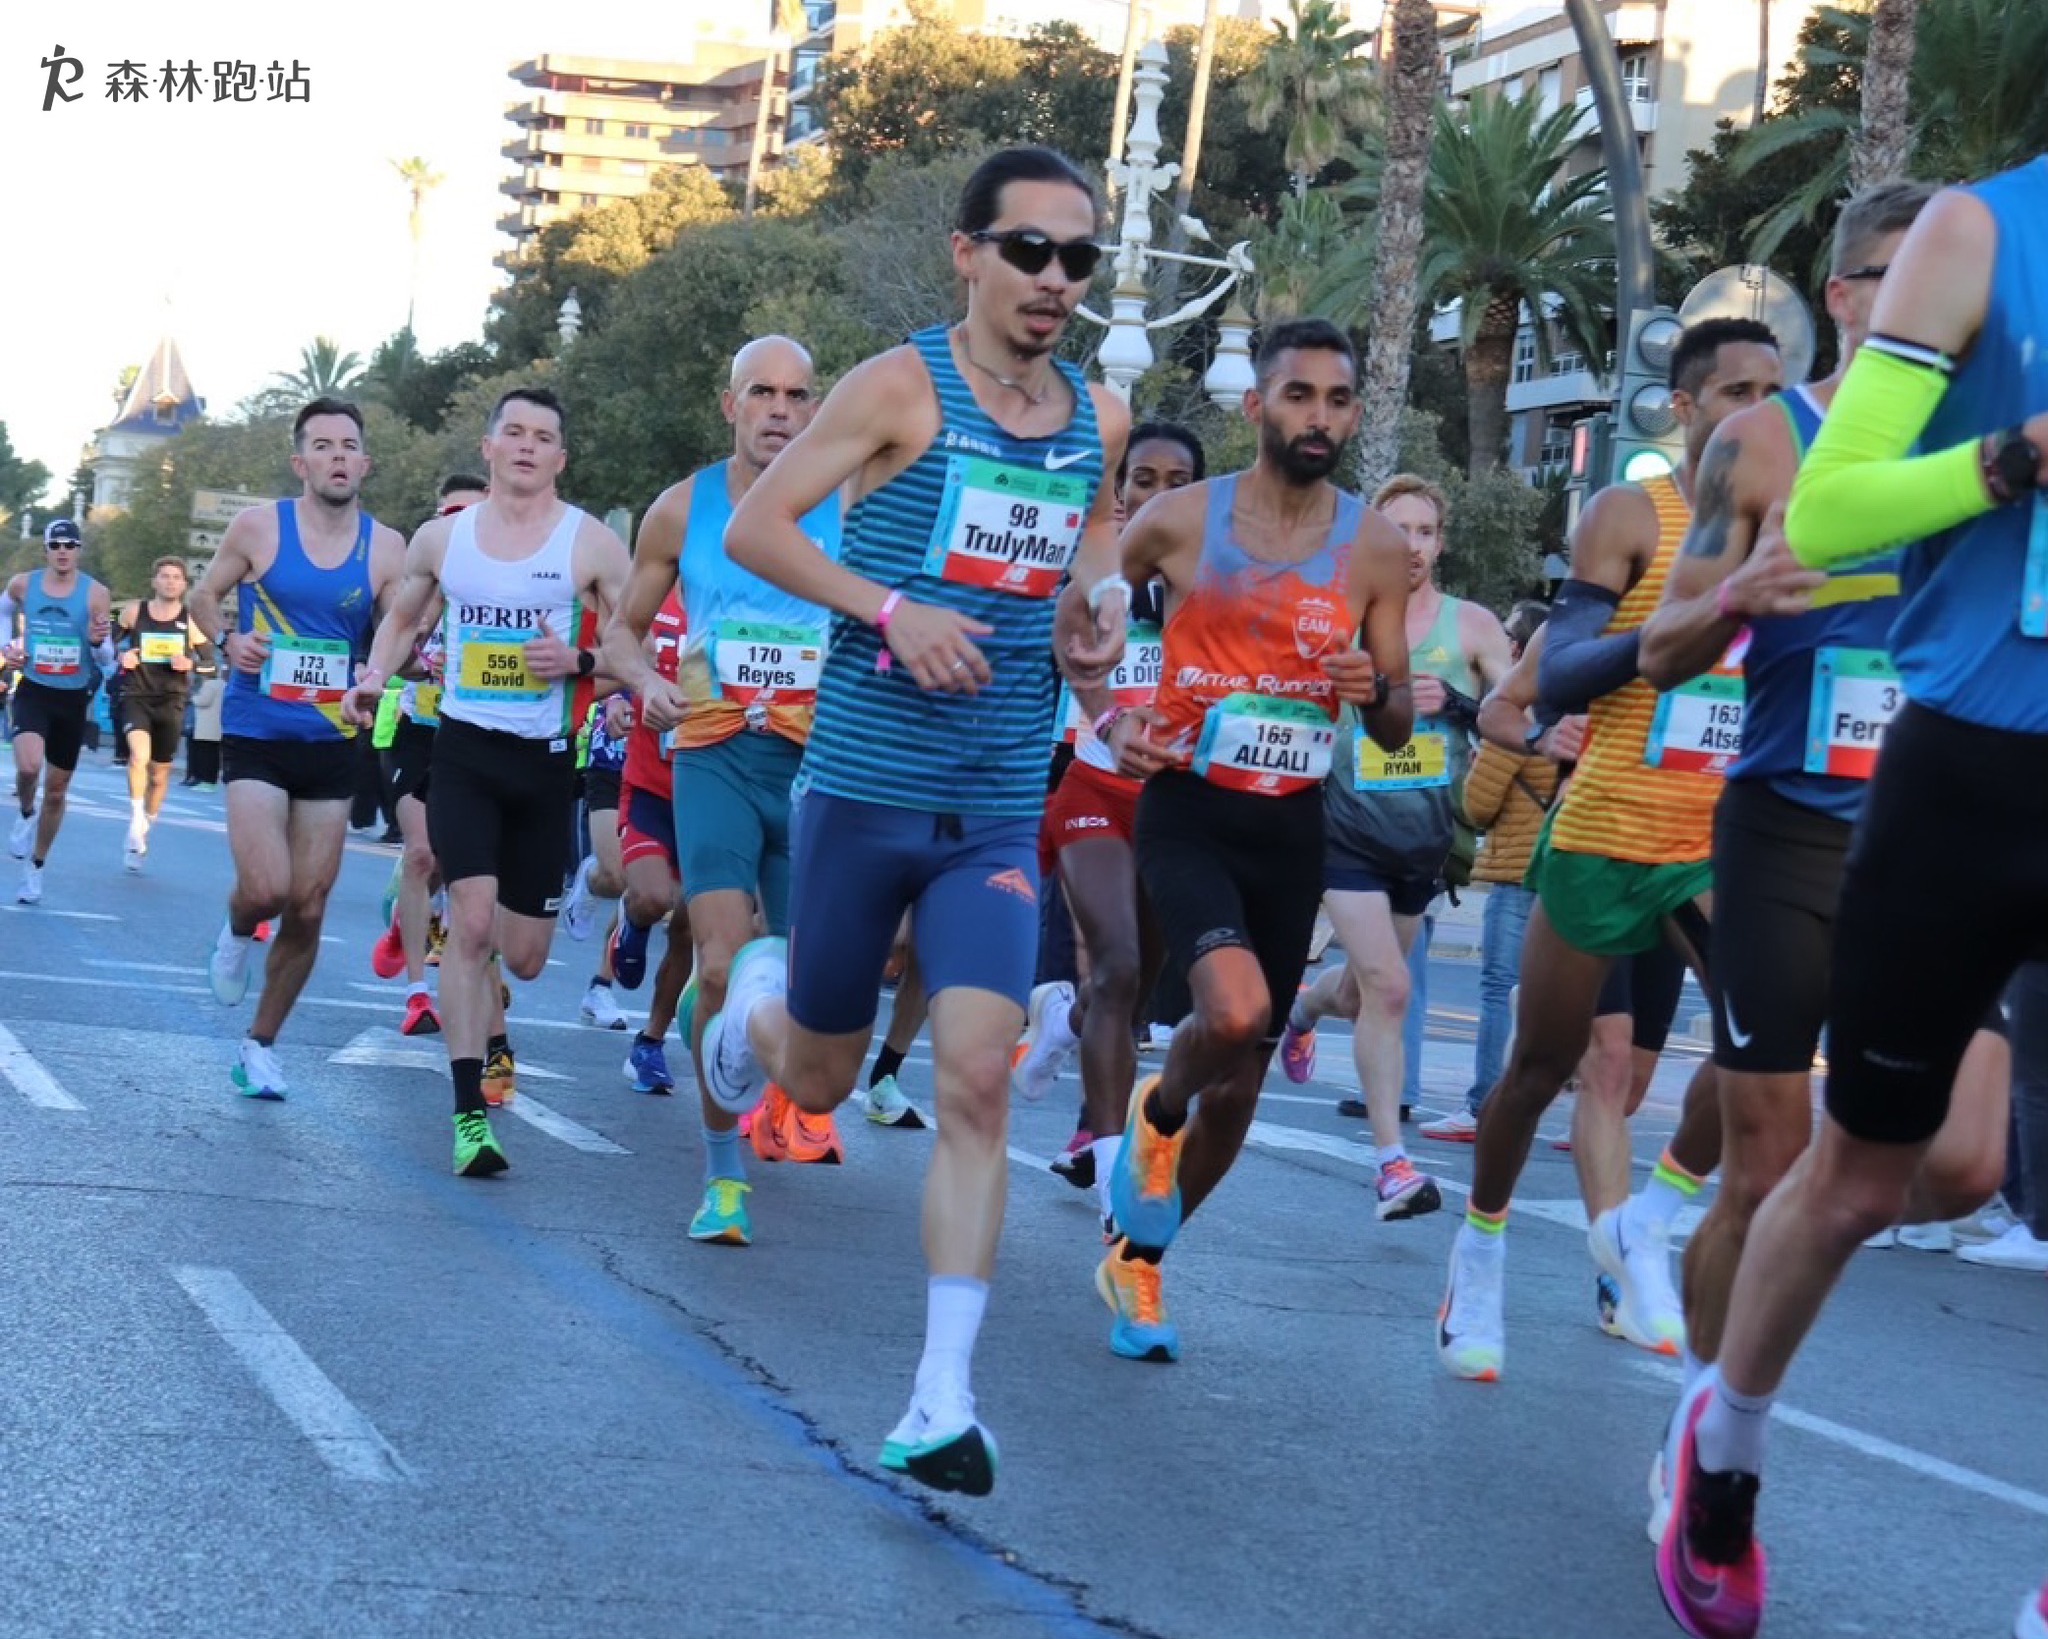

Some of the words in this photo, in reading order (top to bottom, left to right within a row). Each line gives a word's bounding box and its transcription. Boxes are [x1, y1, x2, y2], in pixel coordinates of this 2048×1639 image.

[1009, 503, 1040, 530] 98
[965, 523, 1067, 565] TrulyMan
[1298, 616, 1331, 634] EAM
[299, 655, 325, 670] 173
[487, 654, 519, 670] 556
[747, 646, 783, 665] 170
[293, 669, 330, 687] HALL
[481, 671, 525, 687] David
[737, 664, 796, 689] Reyes
[1256, 722, 1294, 746] 165
[1232, 744, 1310, 773] ALLALI
[1383, 761, 1423, 776] RYAN
